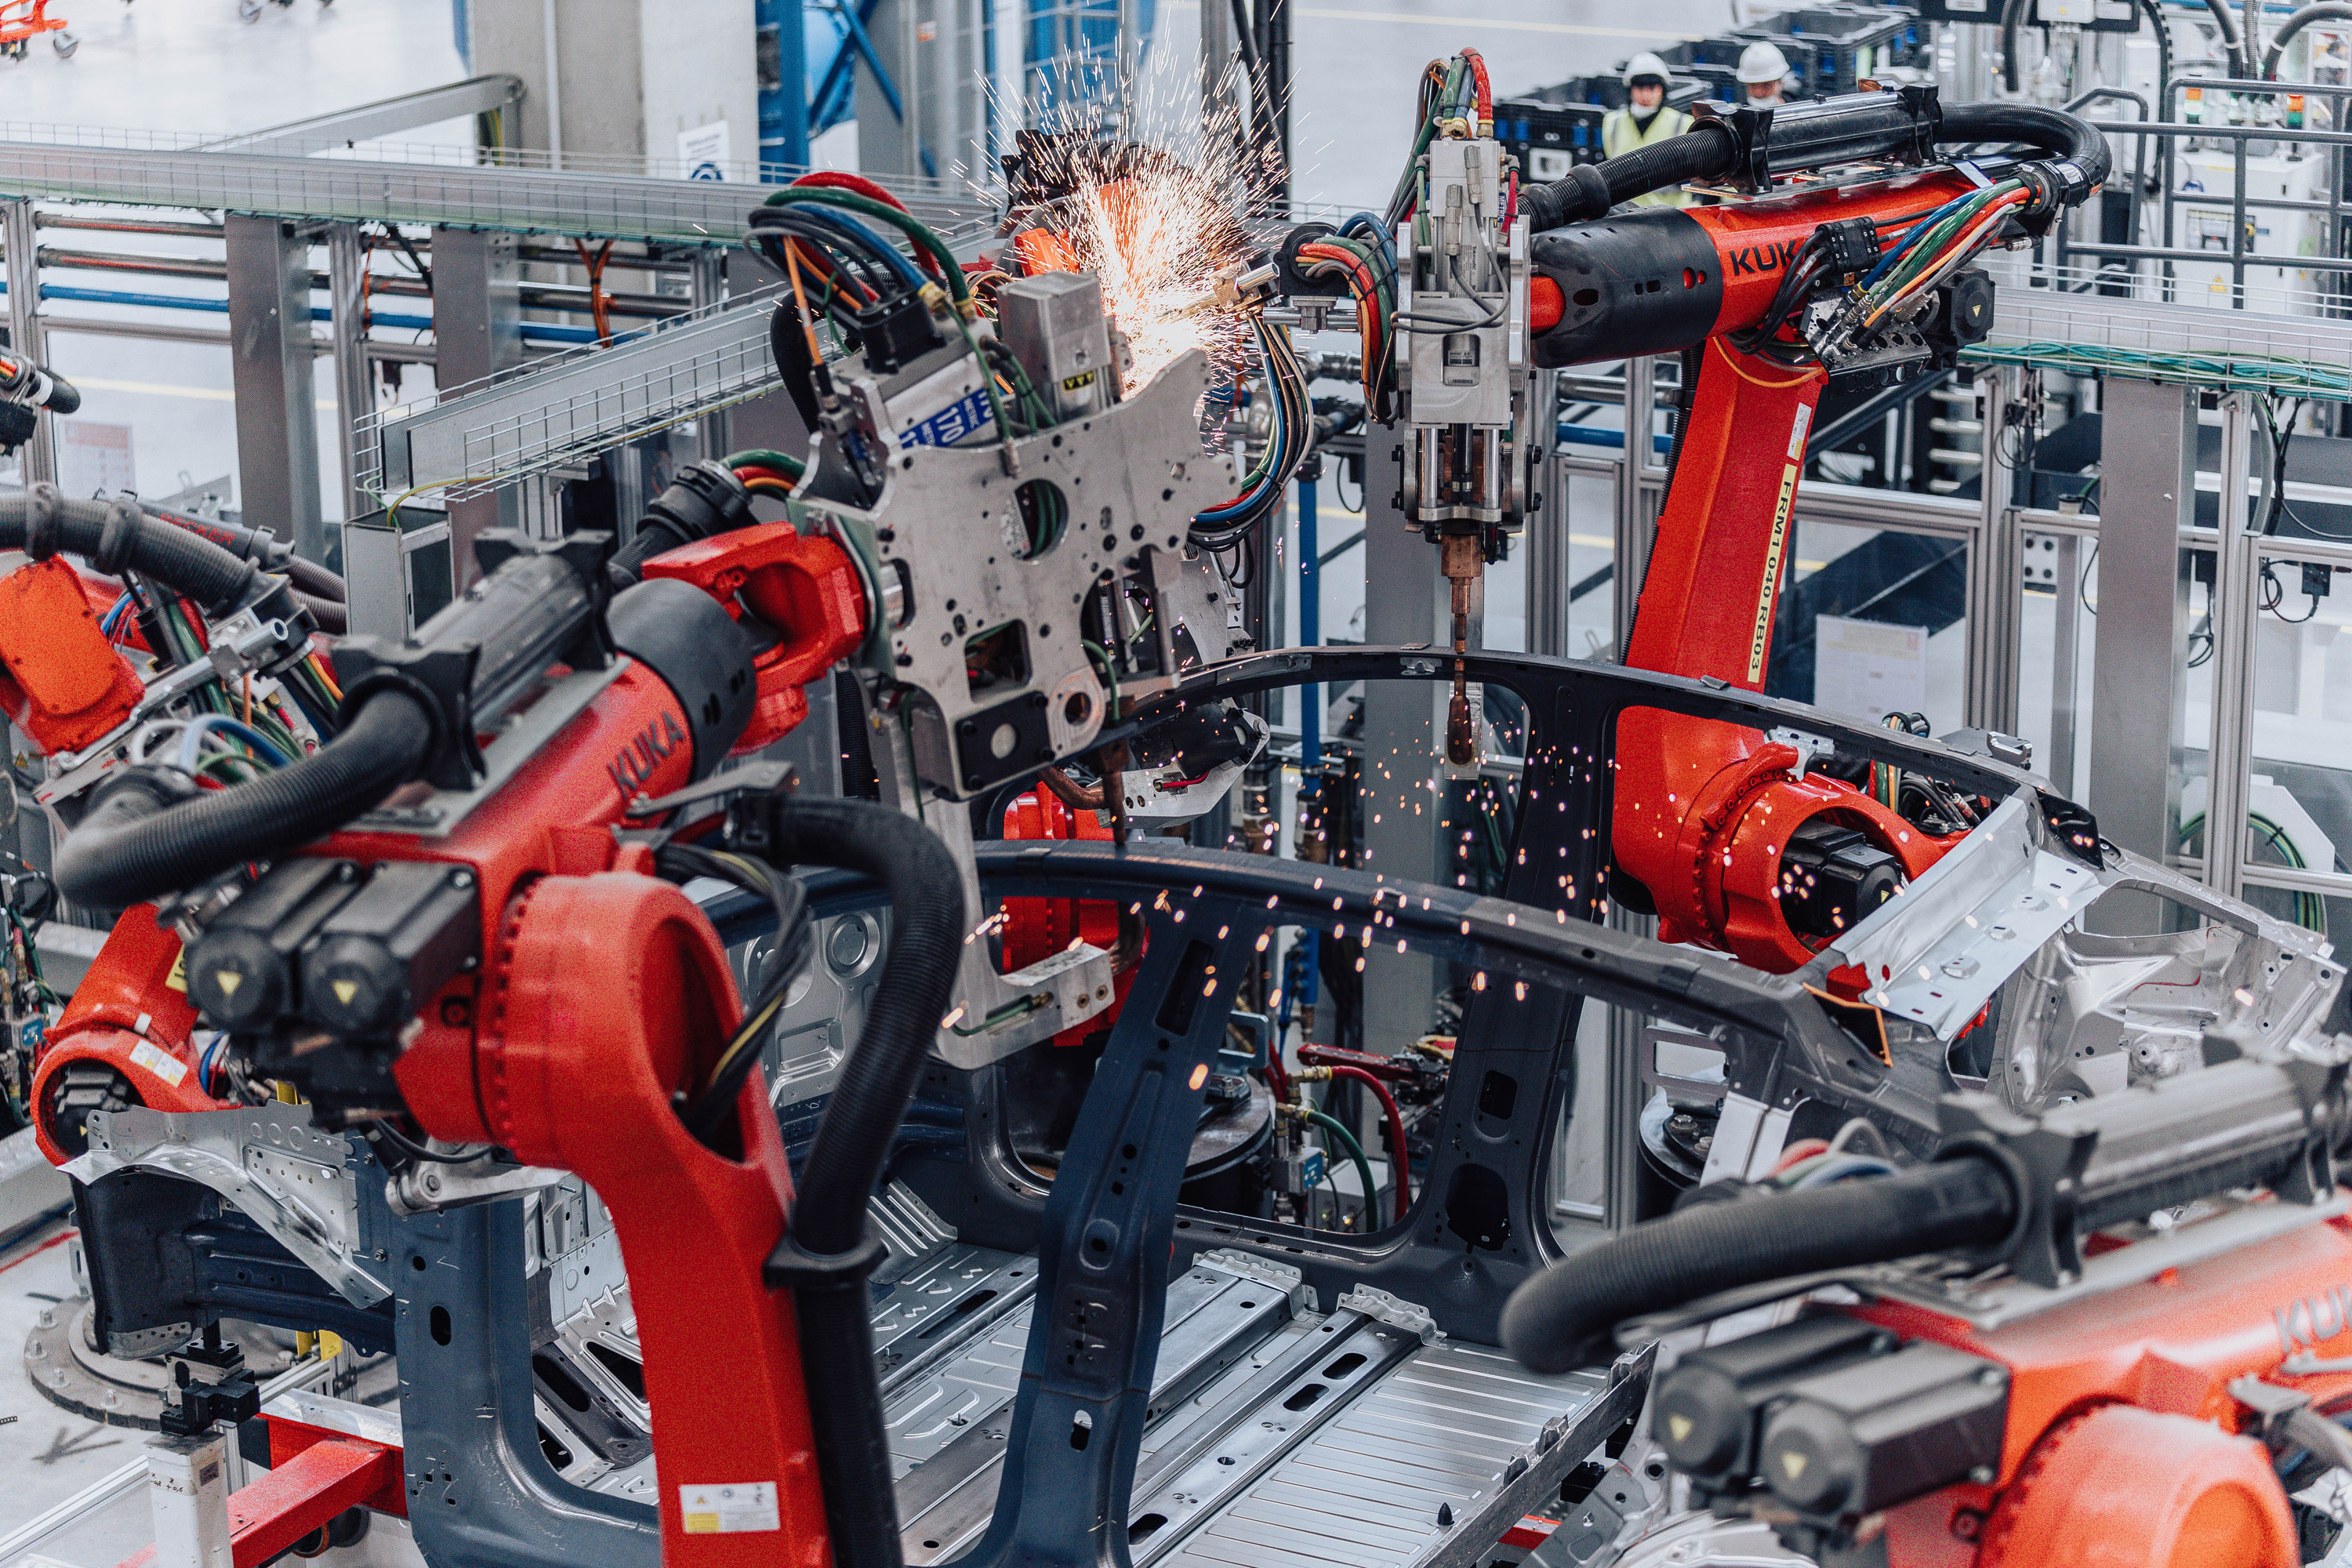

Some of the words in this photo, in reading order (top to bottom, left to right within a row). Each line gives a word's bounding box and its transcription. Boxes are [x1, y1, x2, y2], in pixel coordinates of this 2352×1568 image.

[1498, 195, 1507, 223] METRIC
[935, 407, 965, 443] 170
[964, 397, 979, 429] METRIC
[1772, 481, 1791, 547] FRM1
[1763, 557, 1777, 598] 040
[1751, 606, 1769, 670] RB03
[608, 710, 686, 801] KUKA
[2275, 1286, 2352, 1353] KU
